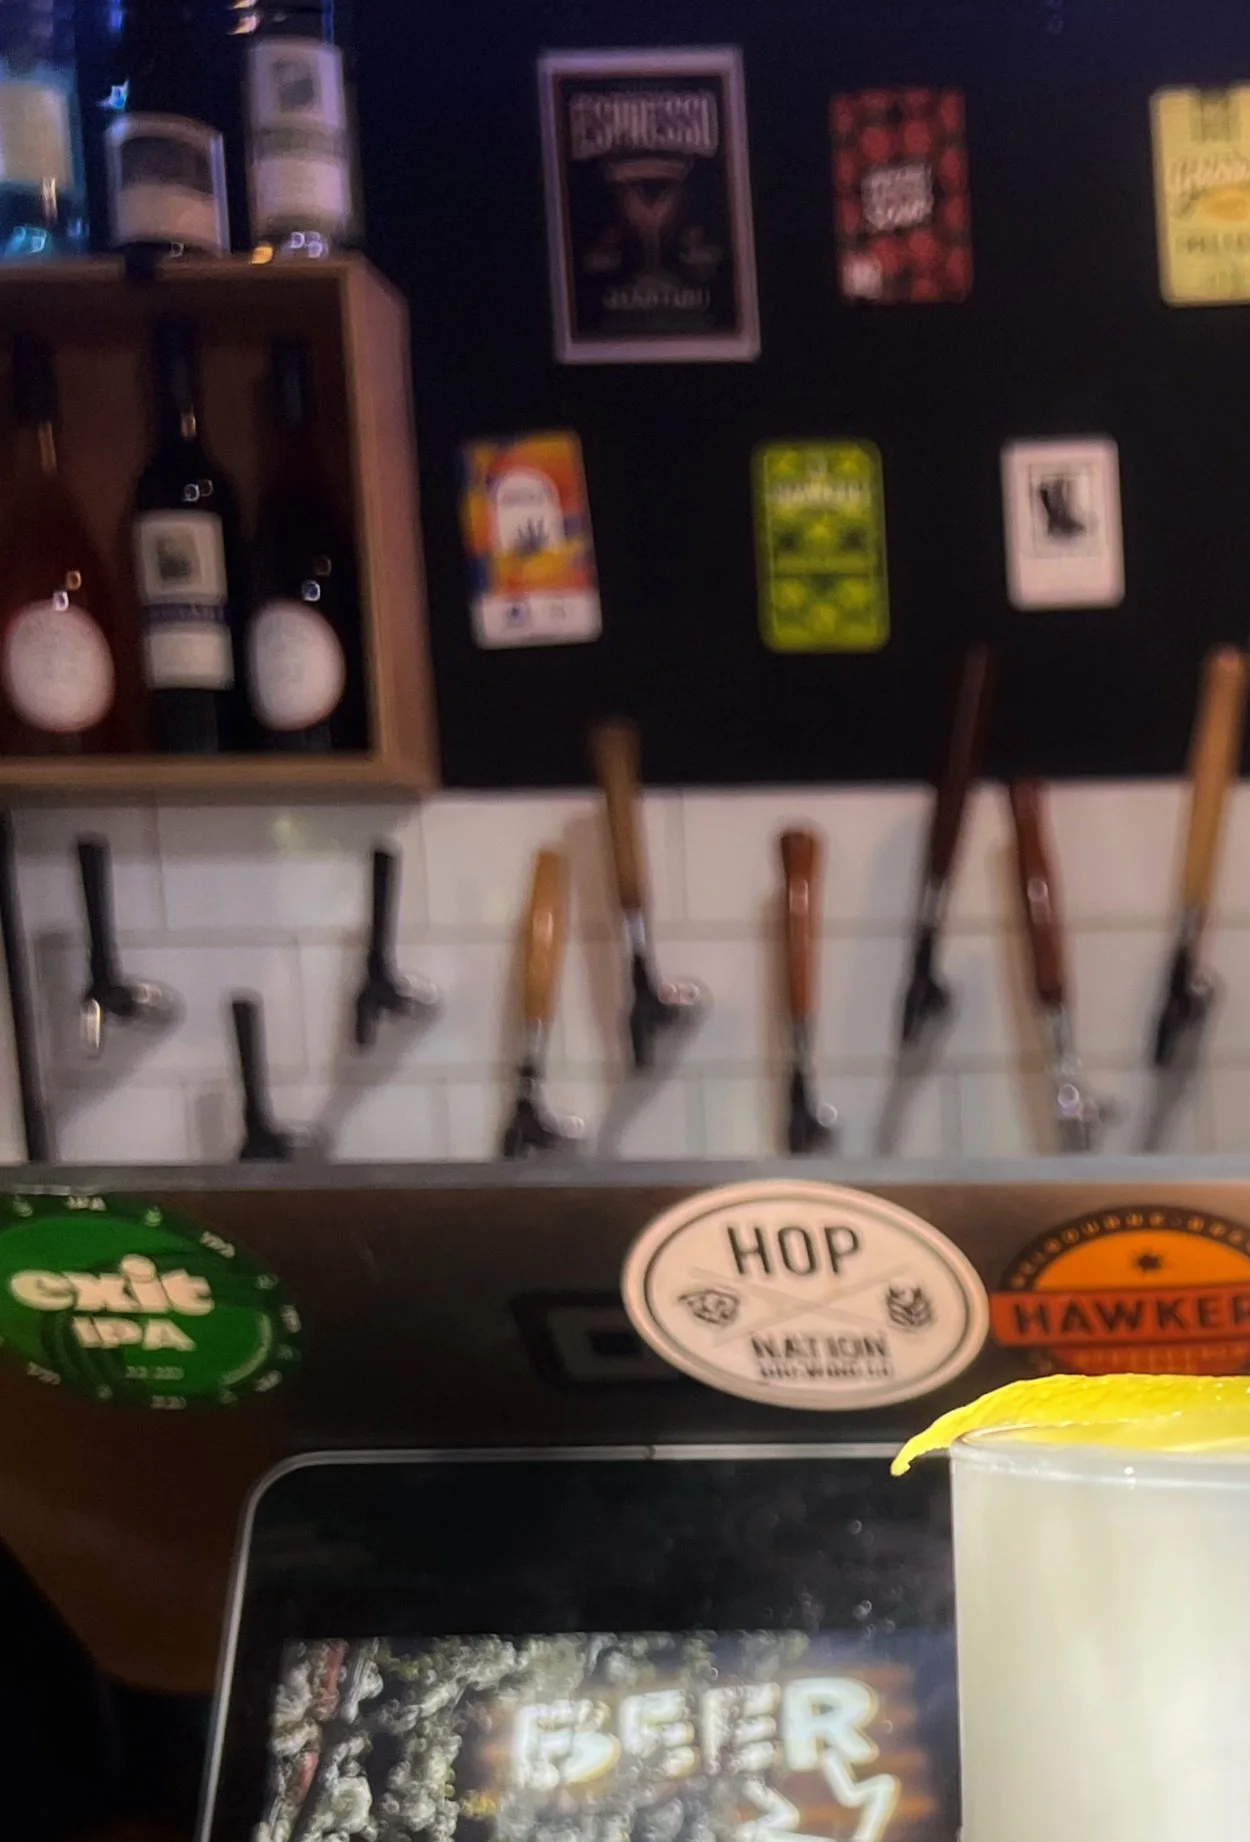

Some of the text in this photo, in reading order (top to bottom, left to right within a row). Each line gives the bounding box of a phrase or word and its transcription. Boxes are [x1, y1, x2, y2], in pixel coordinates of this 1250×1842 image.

[727, 1224, 861, 1276] HOP
[11, 1253, 216, 1317] exit
[72, 1316, 197, 1350] IPA
[750, 1334, 889, 1360] NATION
[511, 1677, 881, 1790] BEER
